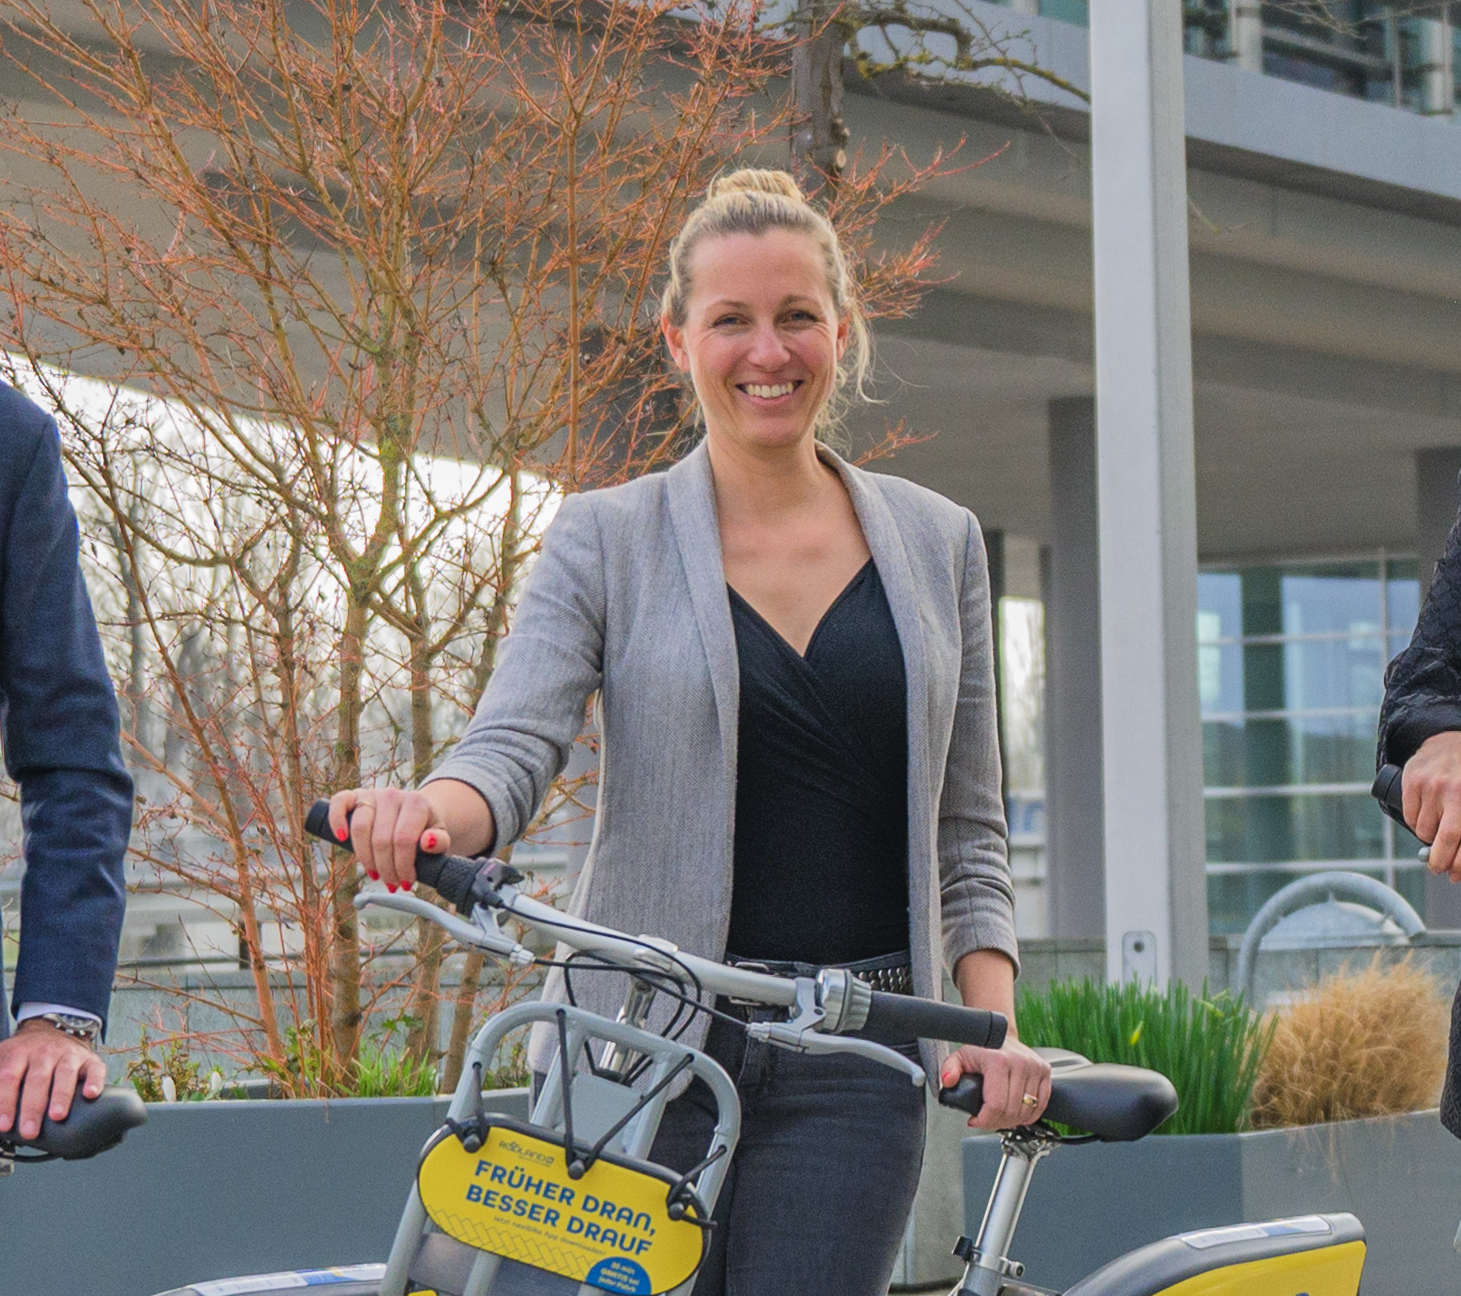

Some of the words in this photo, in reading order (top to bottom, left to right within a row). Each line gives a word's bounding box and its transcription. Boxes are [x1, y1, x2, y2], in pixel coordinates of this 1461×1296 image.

[466, 1183, 561, 1228] BESSER
[566, 1215, 653, 1255] DRAUF
[475, 1159, 576, 1206] FRÜHER
[581, 1194, 656, 1237] DRAN,
